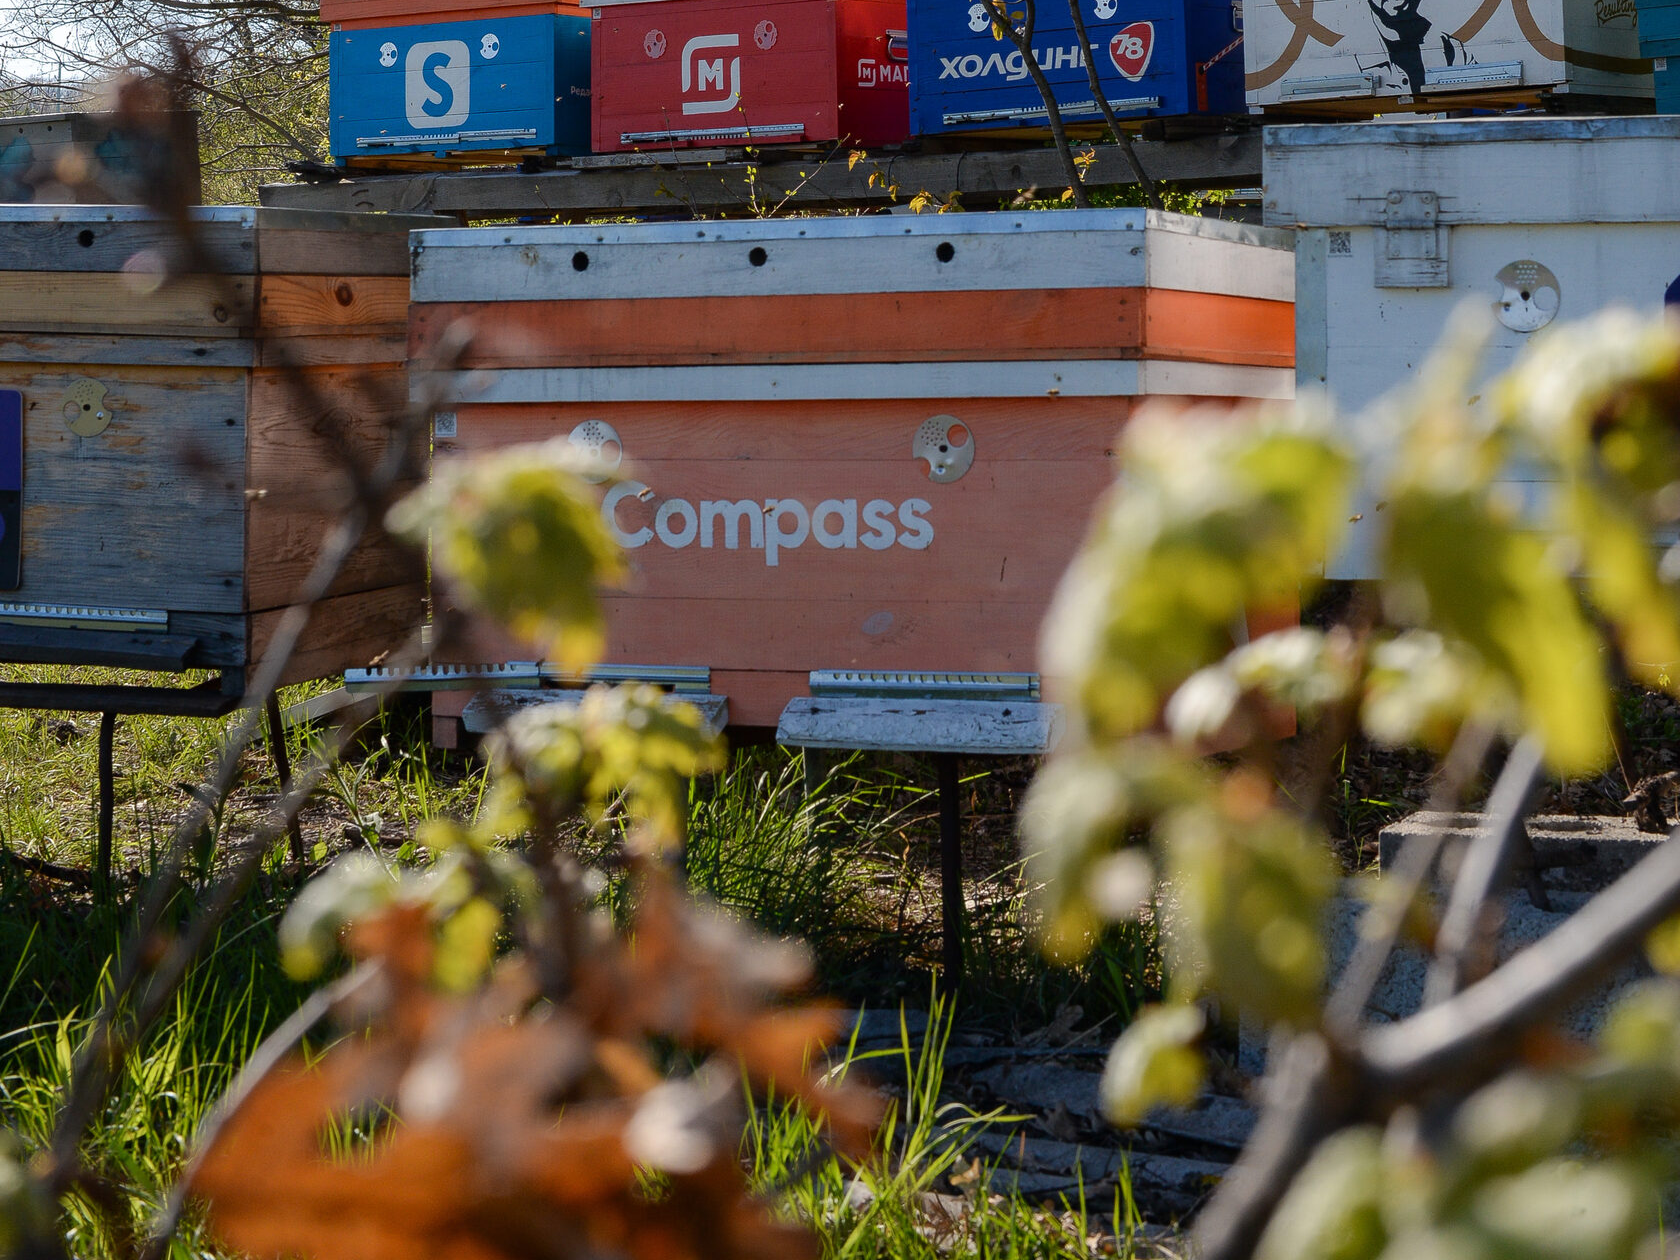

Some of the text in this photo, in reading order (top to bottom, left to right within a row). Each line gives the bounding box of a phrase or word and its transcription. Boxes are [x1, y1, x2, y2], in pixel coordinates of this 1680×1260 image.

[1110, 33, 1144, 60] 78
[421, 51, 454, 118] S
[600, 480, 934, 567] Compass
